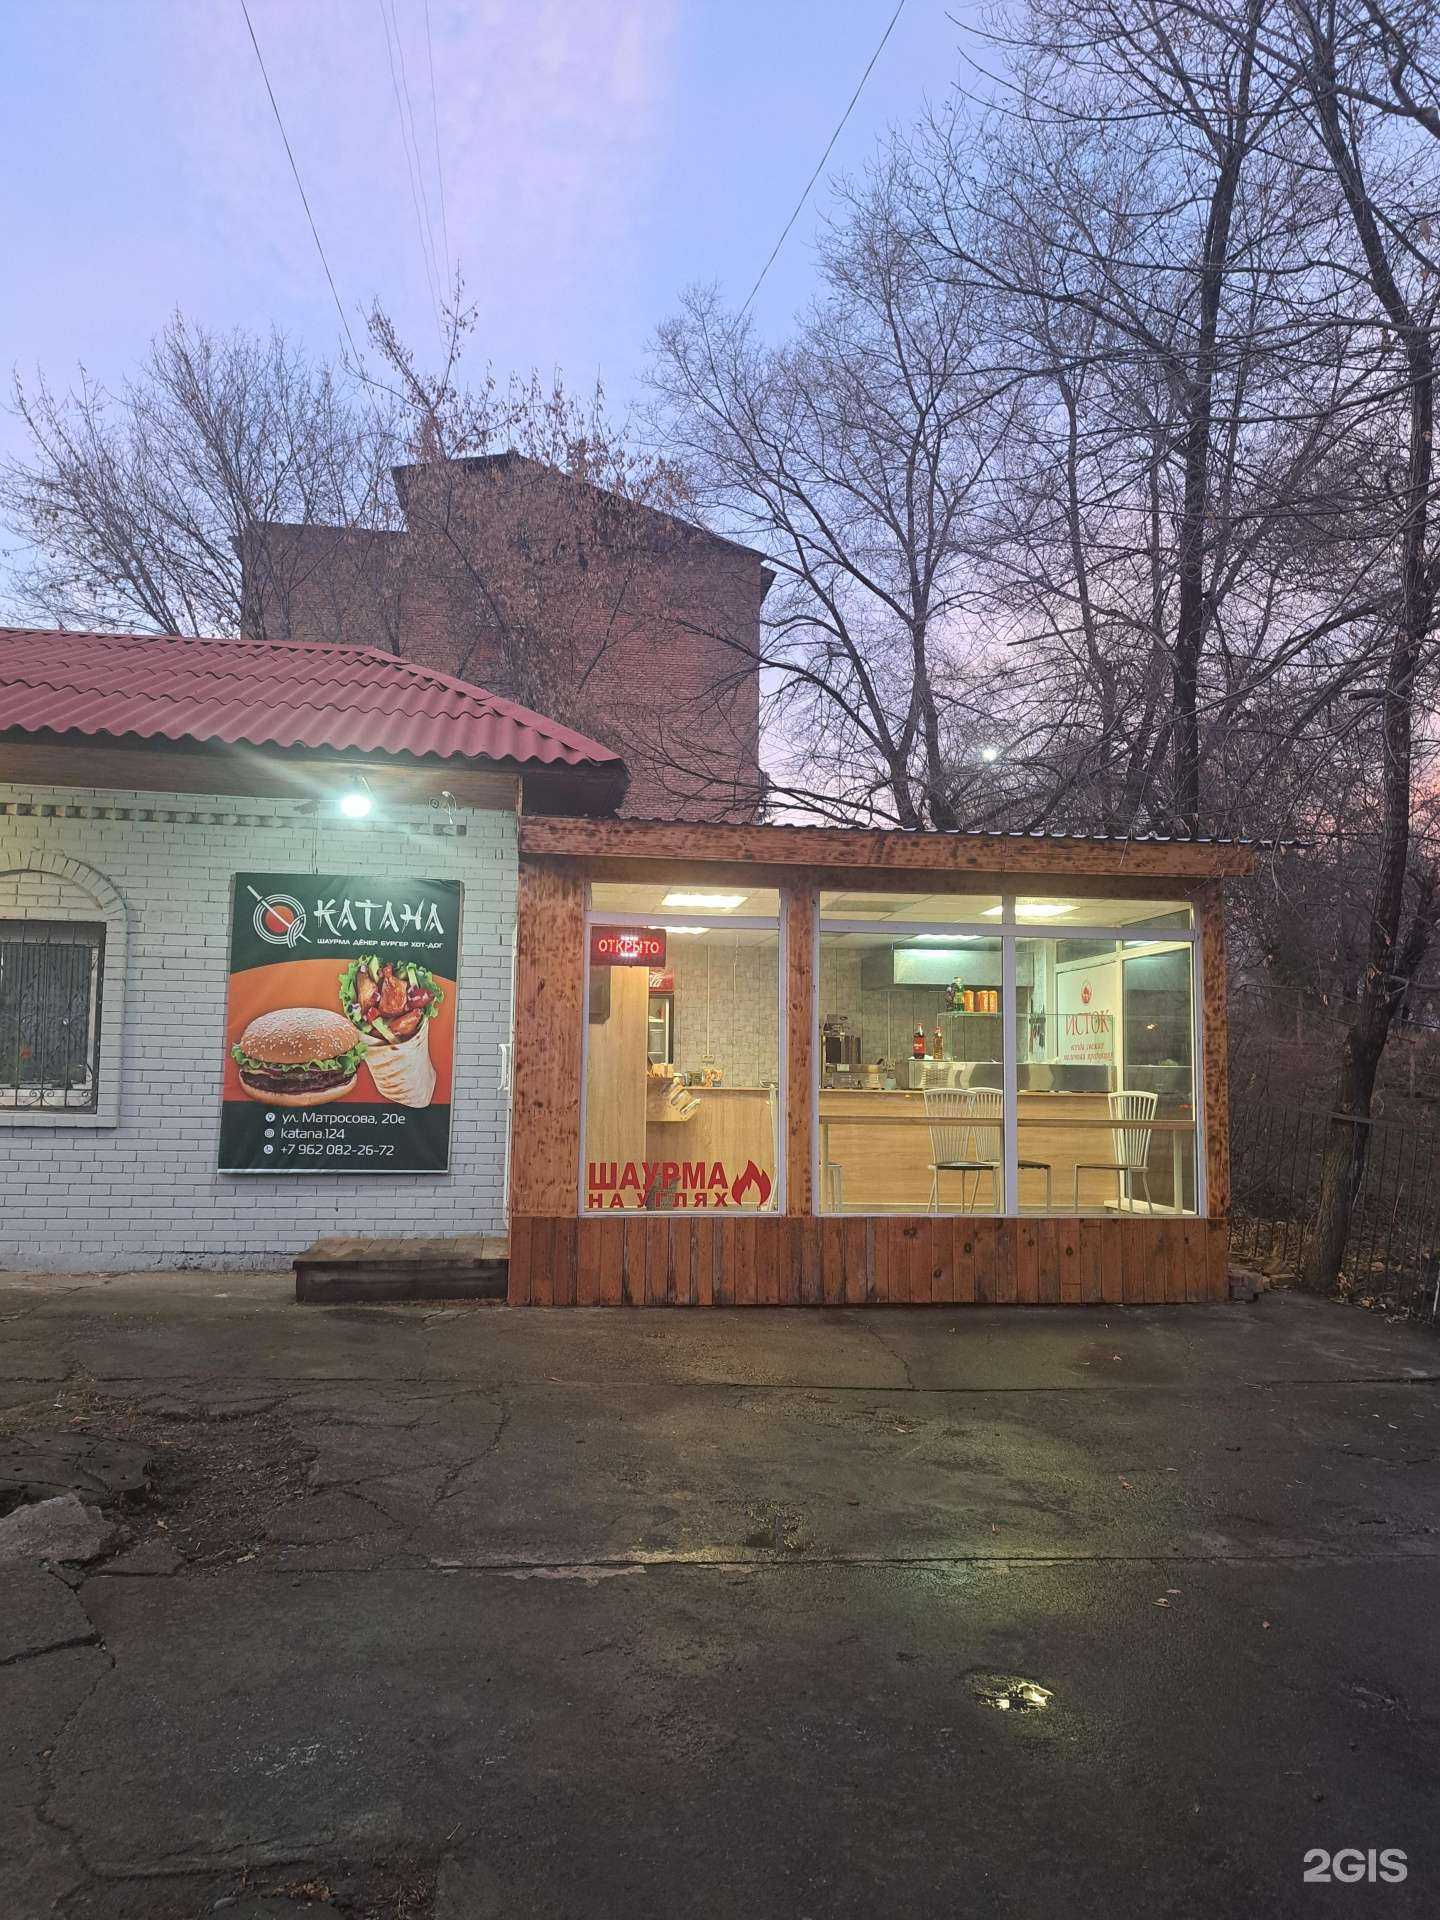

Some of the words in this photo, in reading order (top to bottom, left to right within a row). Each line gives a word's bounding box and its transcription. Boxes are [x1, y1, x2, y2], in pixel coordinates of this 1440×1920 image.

[313, 898, 444, 936] КАТАНА
[598, 939, 659, 954] ОТКРЫТО
[1065, 1010, 1110, 1036] ИСТОК
[281, 1114, 299, 1124] ул.
[302, 1112, 378, 1125] Матросова,
[381, 1113, 406, 1125] 20е
[280, 1128, 345, 1139] katana.124
[280, 1144, 296, 1155] +7
[298, 1144, 323, 1155] 962
[326, 1144, 395, 1156] 082-26-72
[589, 1162, 728, 1190] ШАУРМА
[589, 1193, 624, 1207] НА
[637, 1192, 729, 1207] УГЛЯХ
